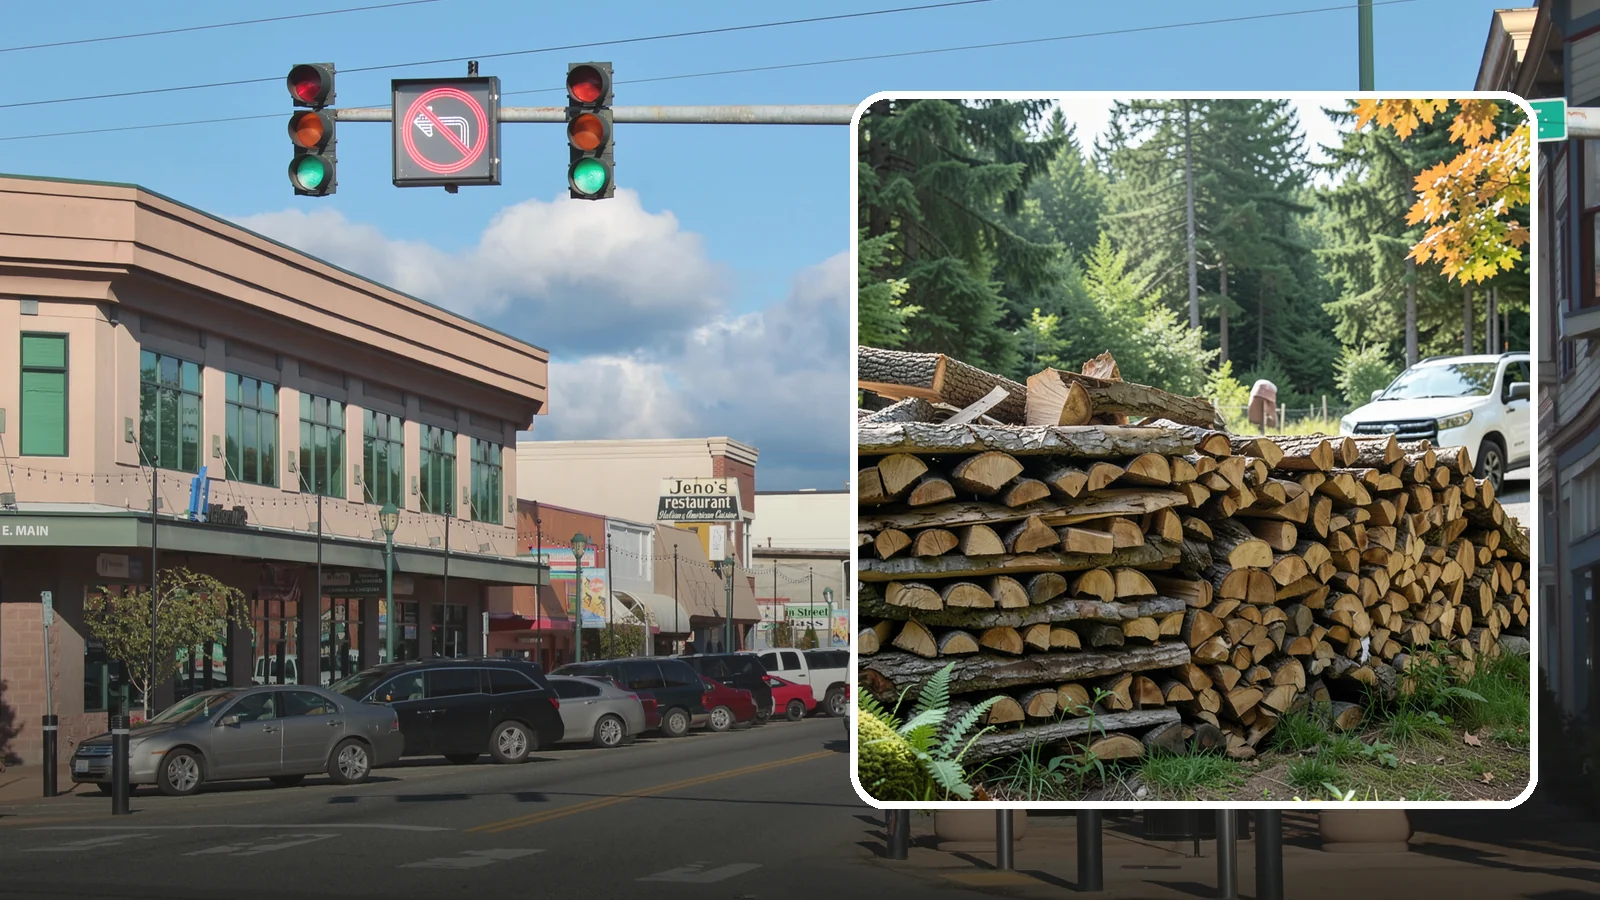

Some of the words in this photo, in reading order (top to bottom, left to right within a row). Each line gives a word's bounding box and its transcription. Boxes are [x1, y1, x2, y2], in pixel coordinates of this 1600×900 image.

[669, 480, 728, 494] Jeno's
[665, 496, 731, 509] restaurant
[658, 509, 681, 520] Italian
[686, 509, 715, 520] American
[715, 509, 738, 520] Cuisine
[2, 525, 13, 536] E.
[15, 525, 49, 536] MAIN
[797, 607, 828, 617] Street
